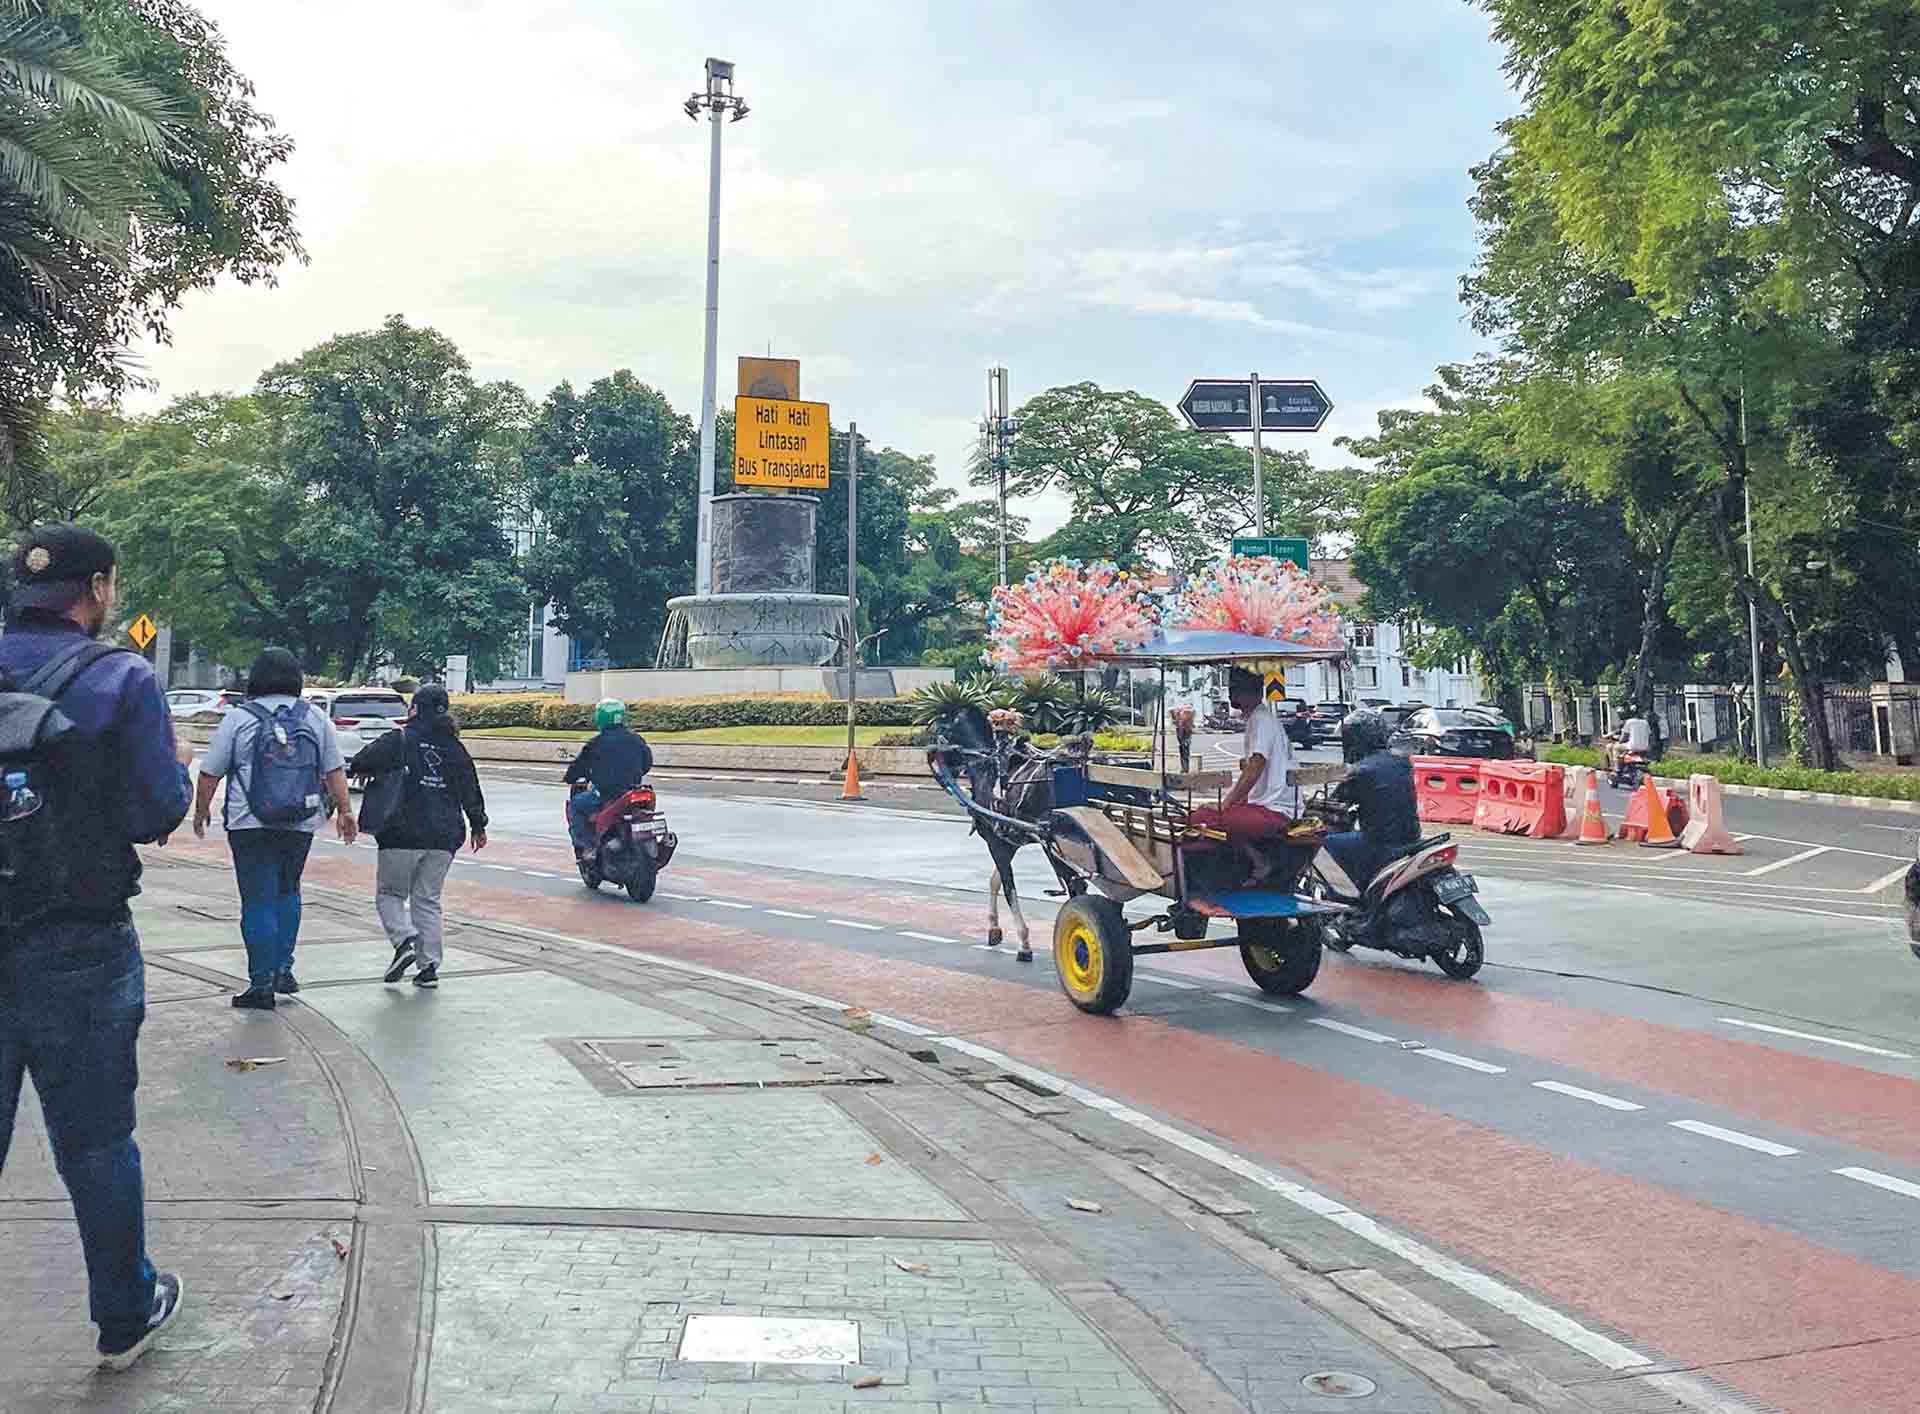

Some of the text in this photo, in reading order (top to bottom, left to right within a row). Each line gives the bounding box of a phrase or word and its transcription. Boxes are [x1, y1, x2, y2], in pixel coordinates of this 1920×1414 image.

[756, 405, 810, 426] Hati Hati
[759, 430, 807, 452] Lintasan
[738, 457, 826, 483] Bus Transjakarta
